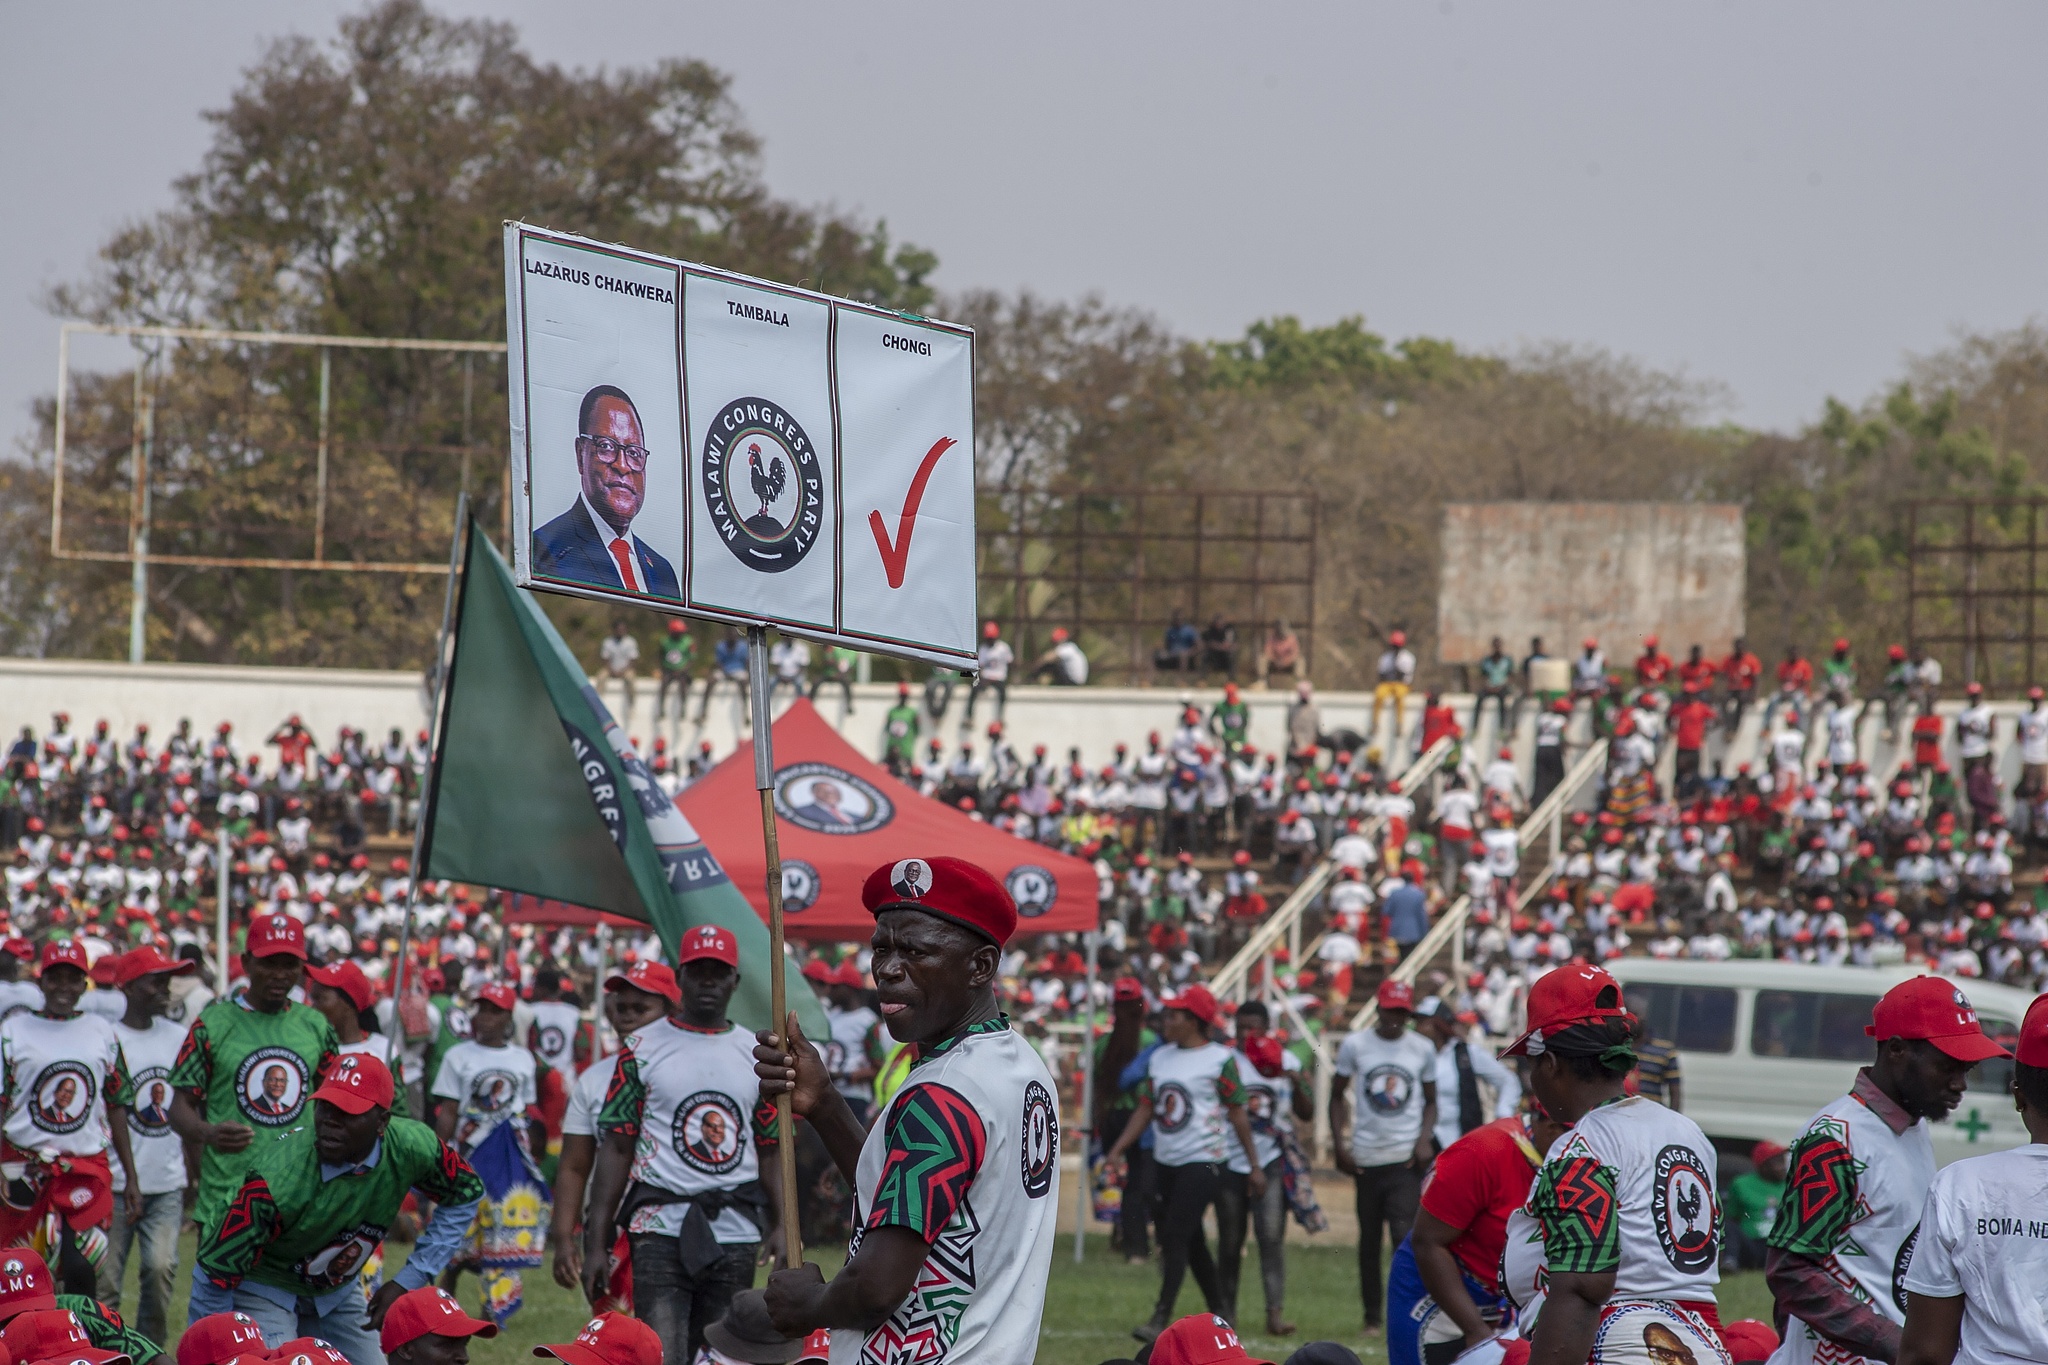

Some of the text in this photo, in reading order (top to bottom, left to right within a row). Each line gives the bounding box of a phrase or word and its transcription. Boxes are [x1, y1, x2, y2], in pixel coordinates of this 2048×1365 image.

[525, 258, 674, 305] LAZARUS CHAKWERA
[726, 300, 790, 328] TAMBALA
[882, 333, 932, 357] CHONGI
[707, 404, 819, 553] MALAWI CONGRESS PARTY
[266, 929, 296, 941] LMC
[694, 938, 725, 951] LMC
[330, 1069, 362, 1087] LMC
[1025, 1085, 1052, 1115] CONGRESS
[1655, 1184, 1677, 1261] MALAWI
[1977, 1217, 2024, 1237] BOMA
[0, 1274, 34, 1294] LMC
